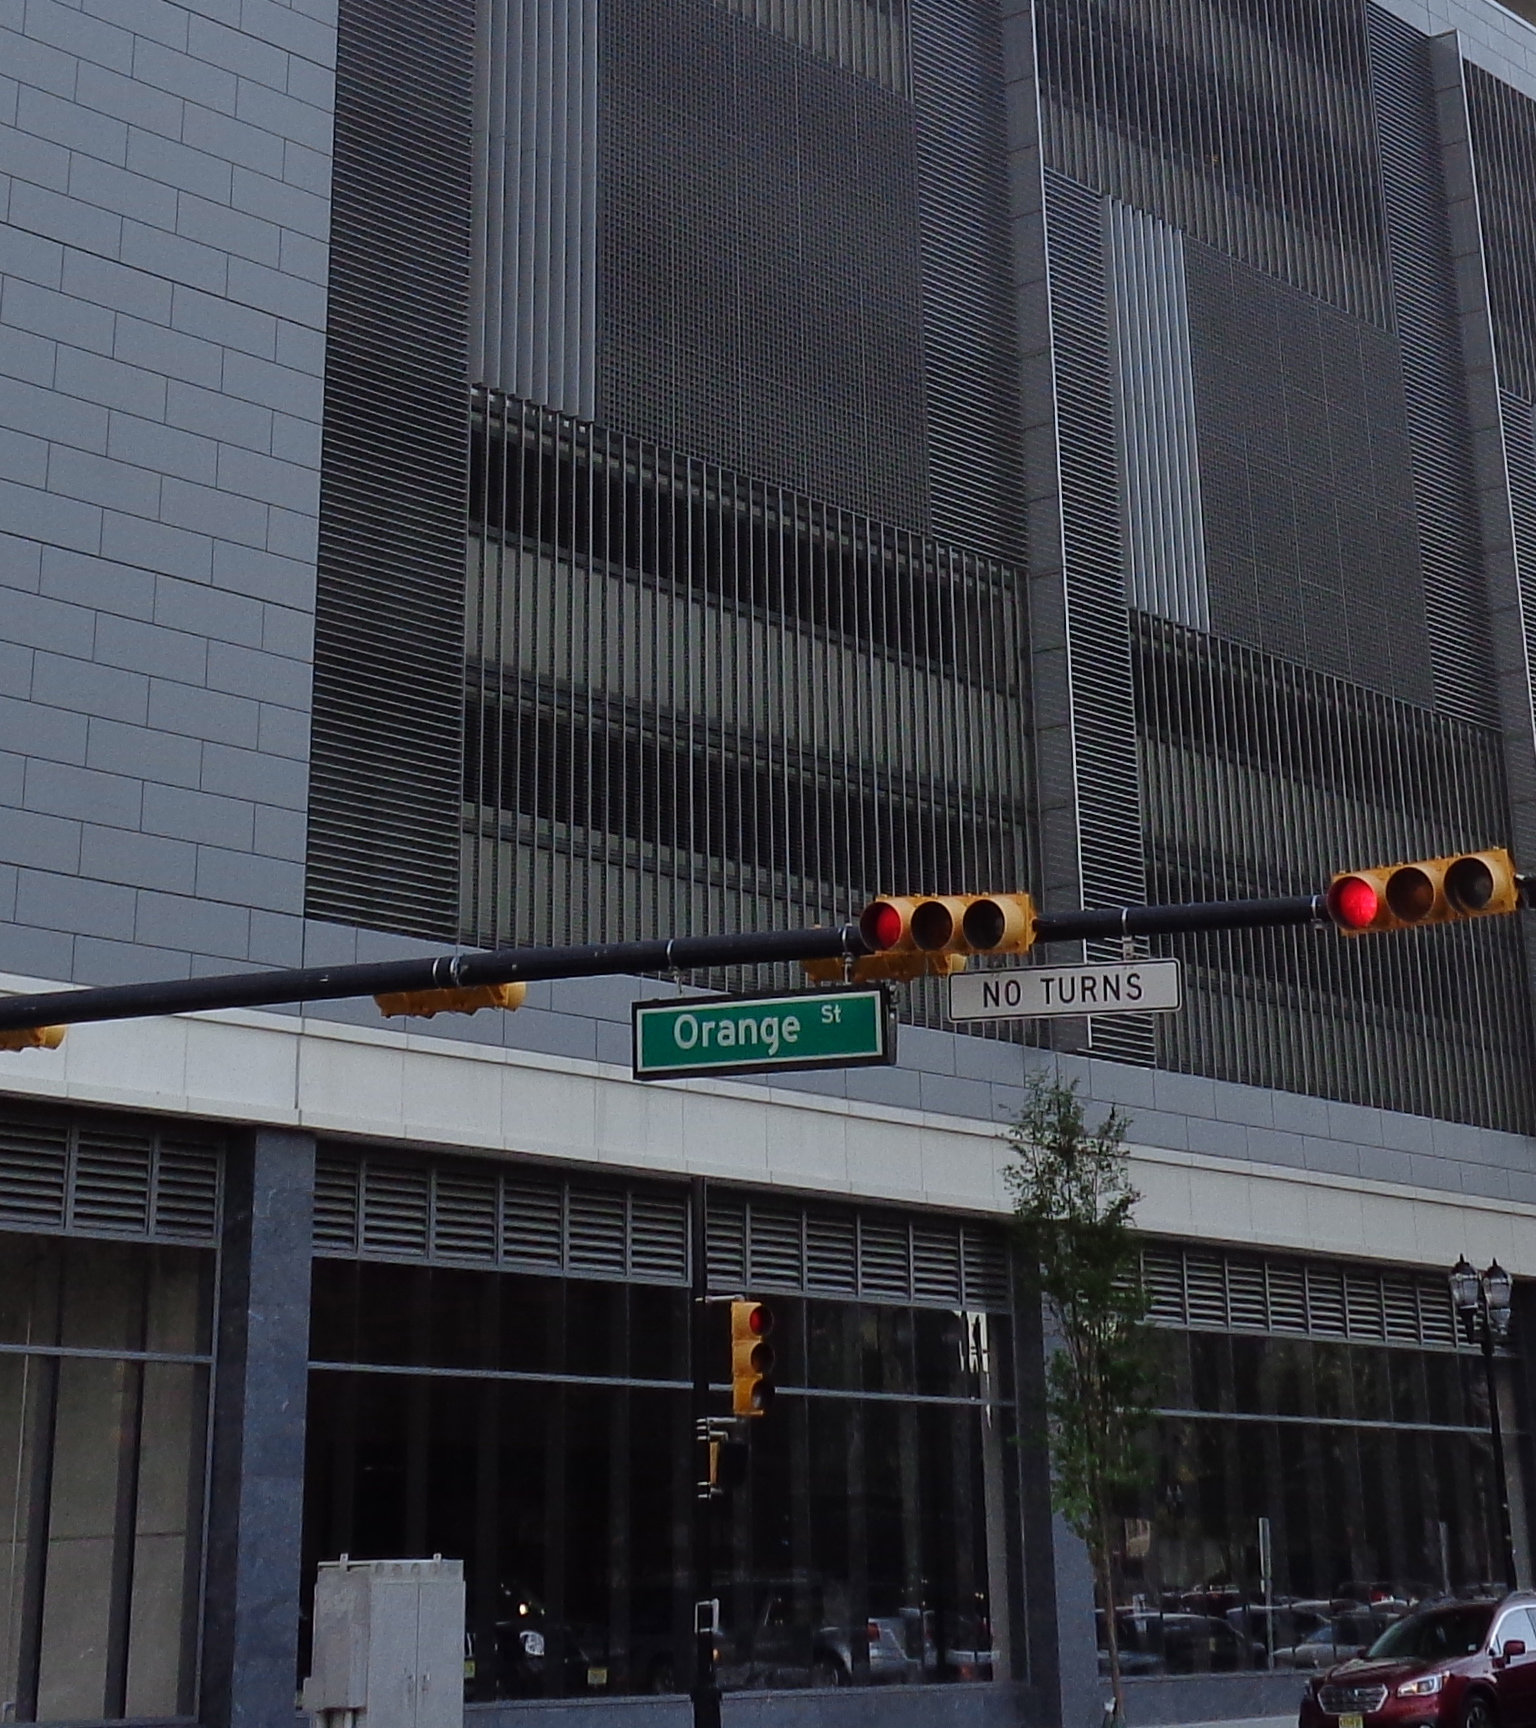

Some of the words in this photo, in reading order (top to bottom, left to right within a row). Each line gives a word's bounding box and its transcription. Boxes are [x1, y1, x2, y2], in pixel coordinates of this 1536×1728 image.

[982, 980, 1022, 1008] NO
[1040, 973, 1144, 1005] TURNS
[673, 1012, 802, 1055] Orange
[820, 1004, 842, 1024] St
